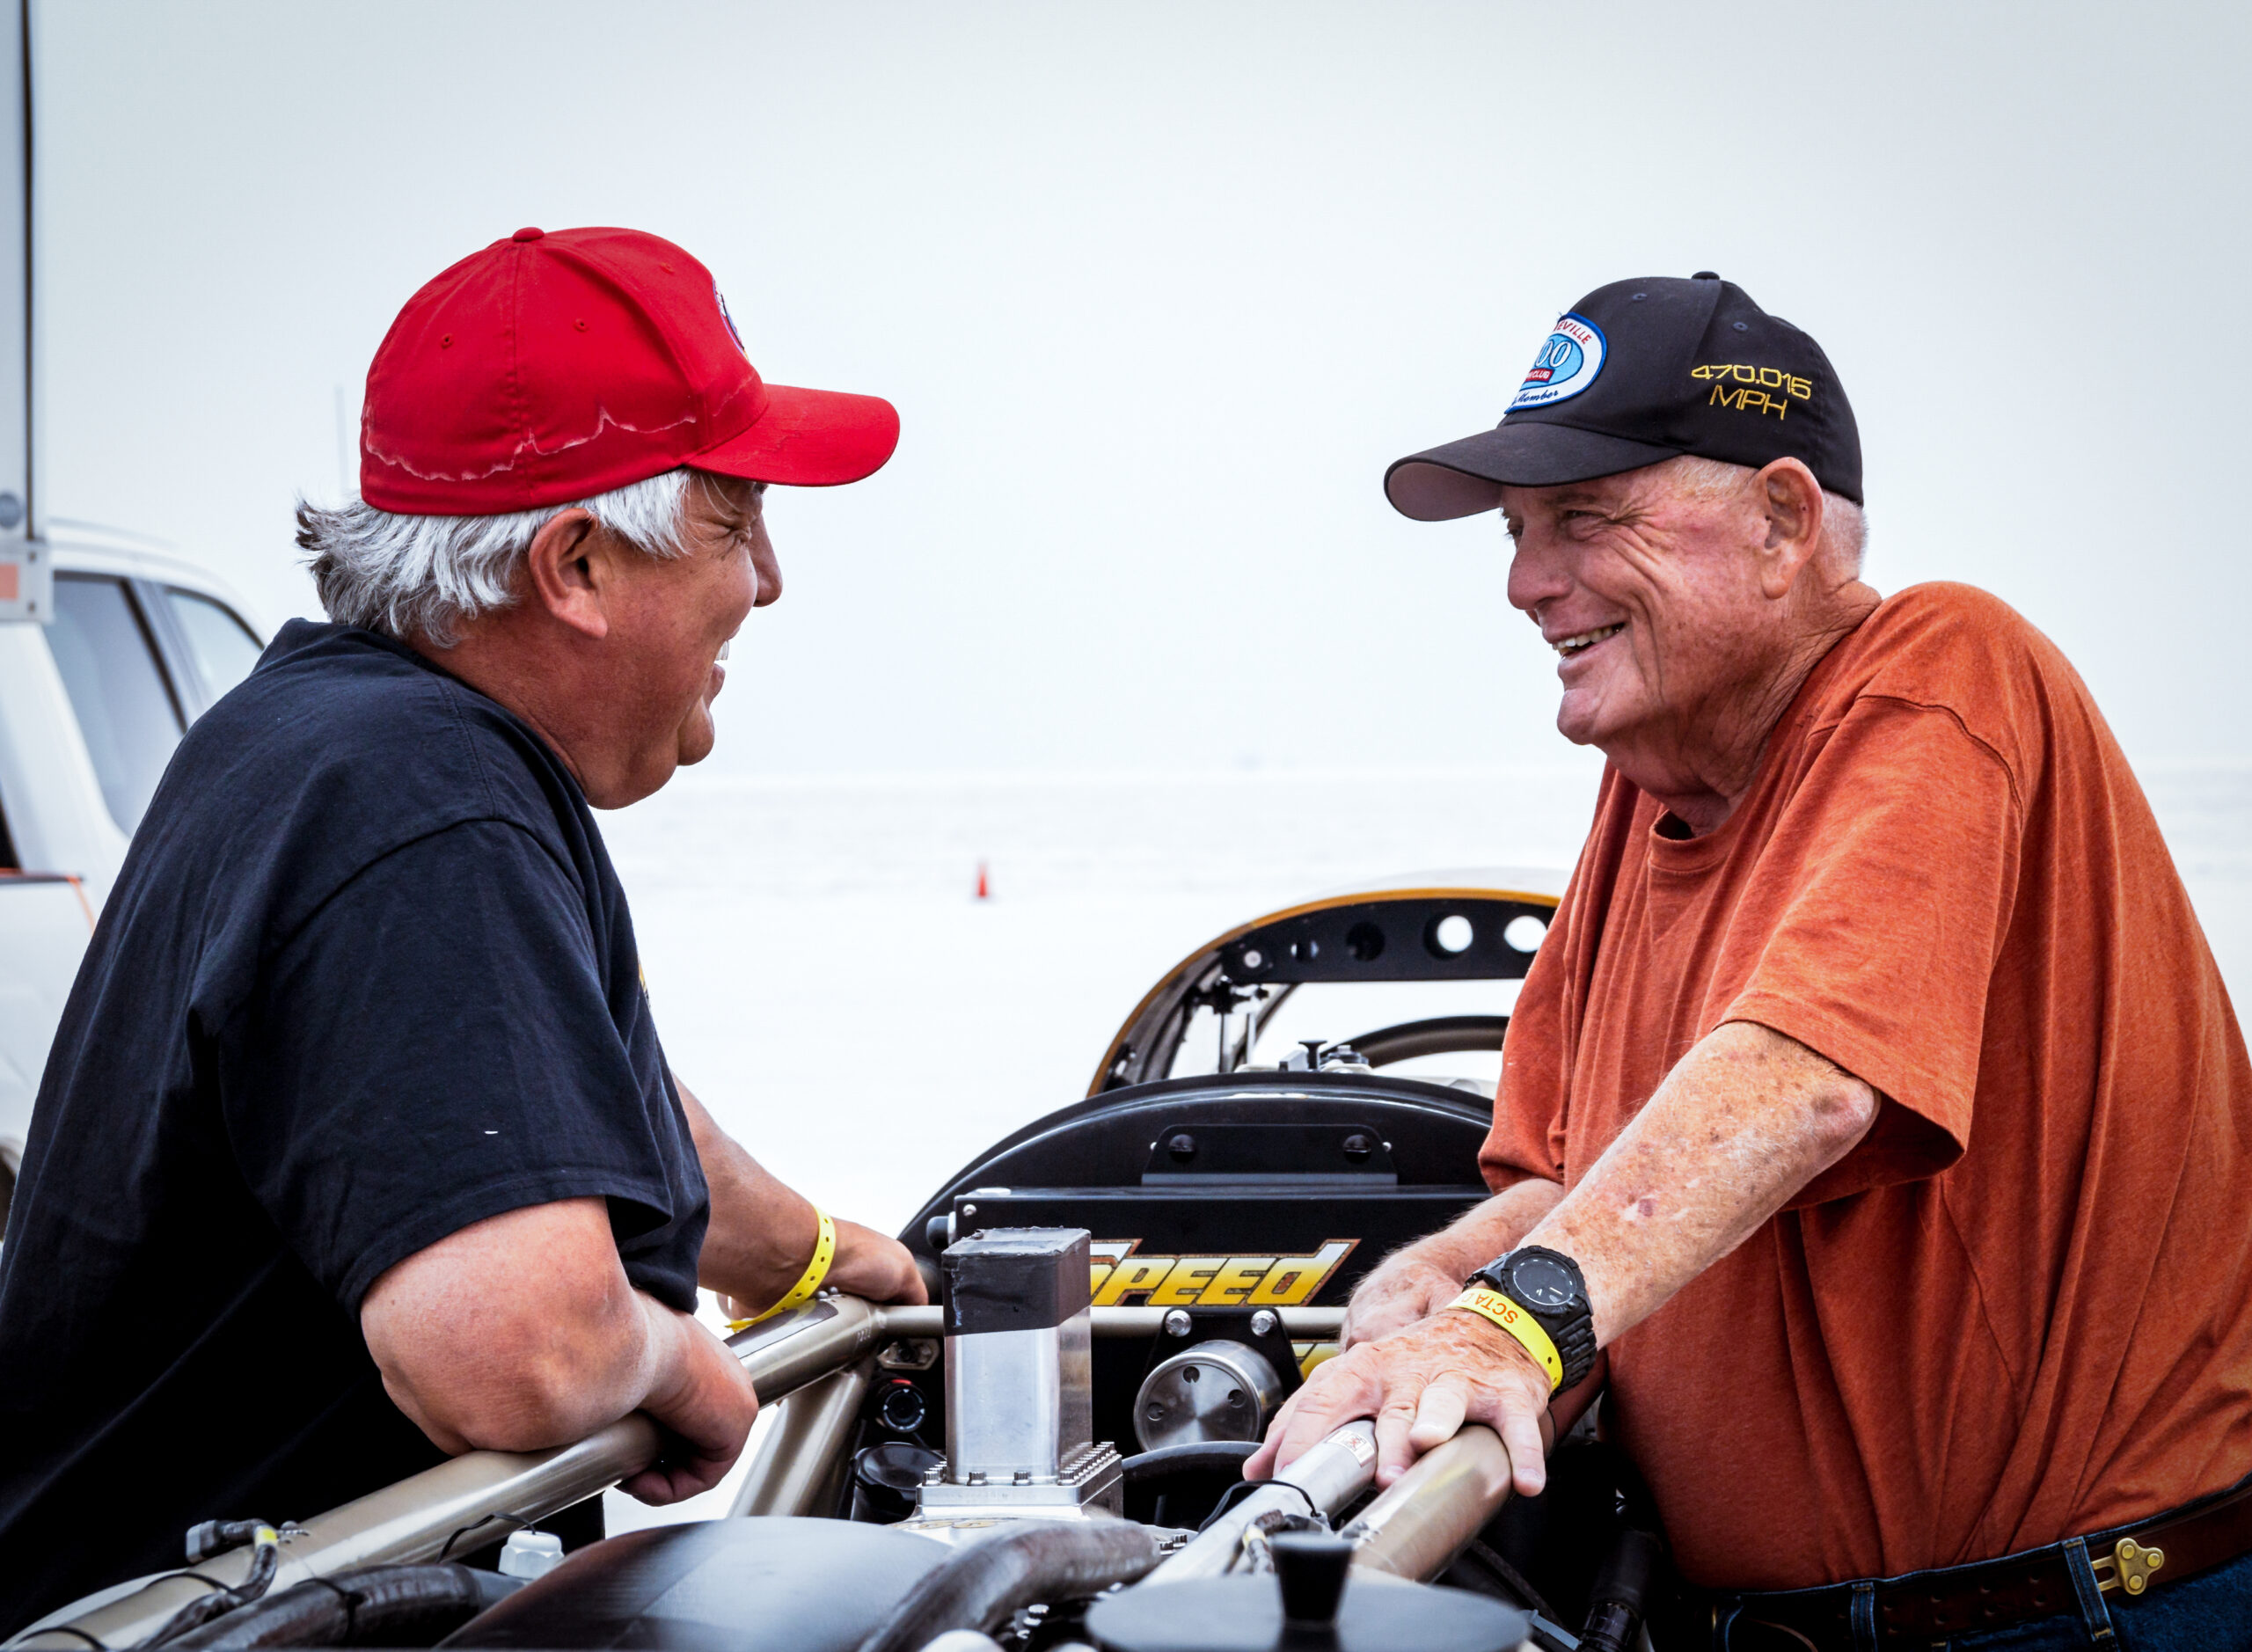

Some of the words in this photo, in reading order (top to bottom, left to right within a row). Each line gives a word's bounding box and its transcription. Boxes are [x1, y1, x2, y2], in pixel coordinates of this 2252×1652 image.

[1691, 364, 1812, 400] 470.015
[1709, 384, 1788, 420] MPH
[1474, 1294, 1518, 1324] SCTA
